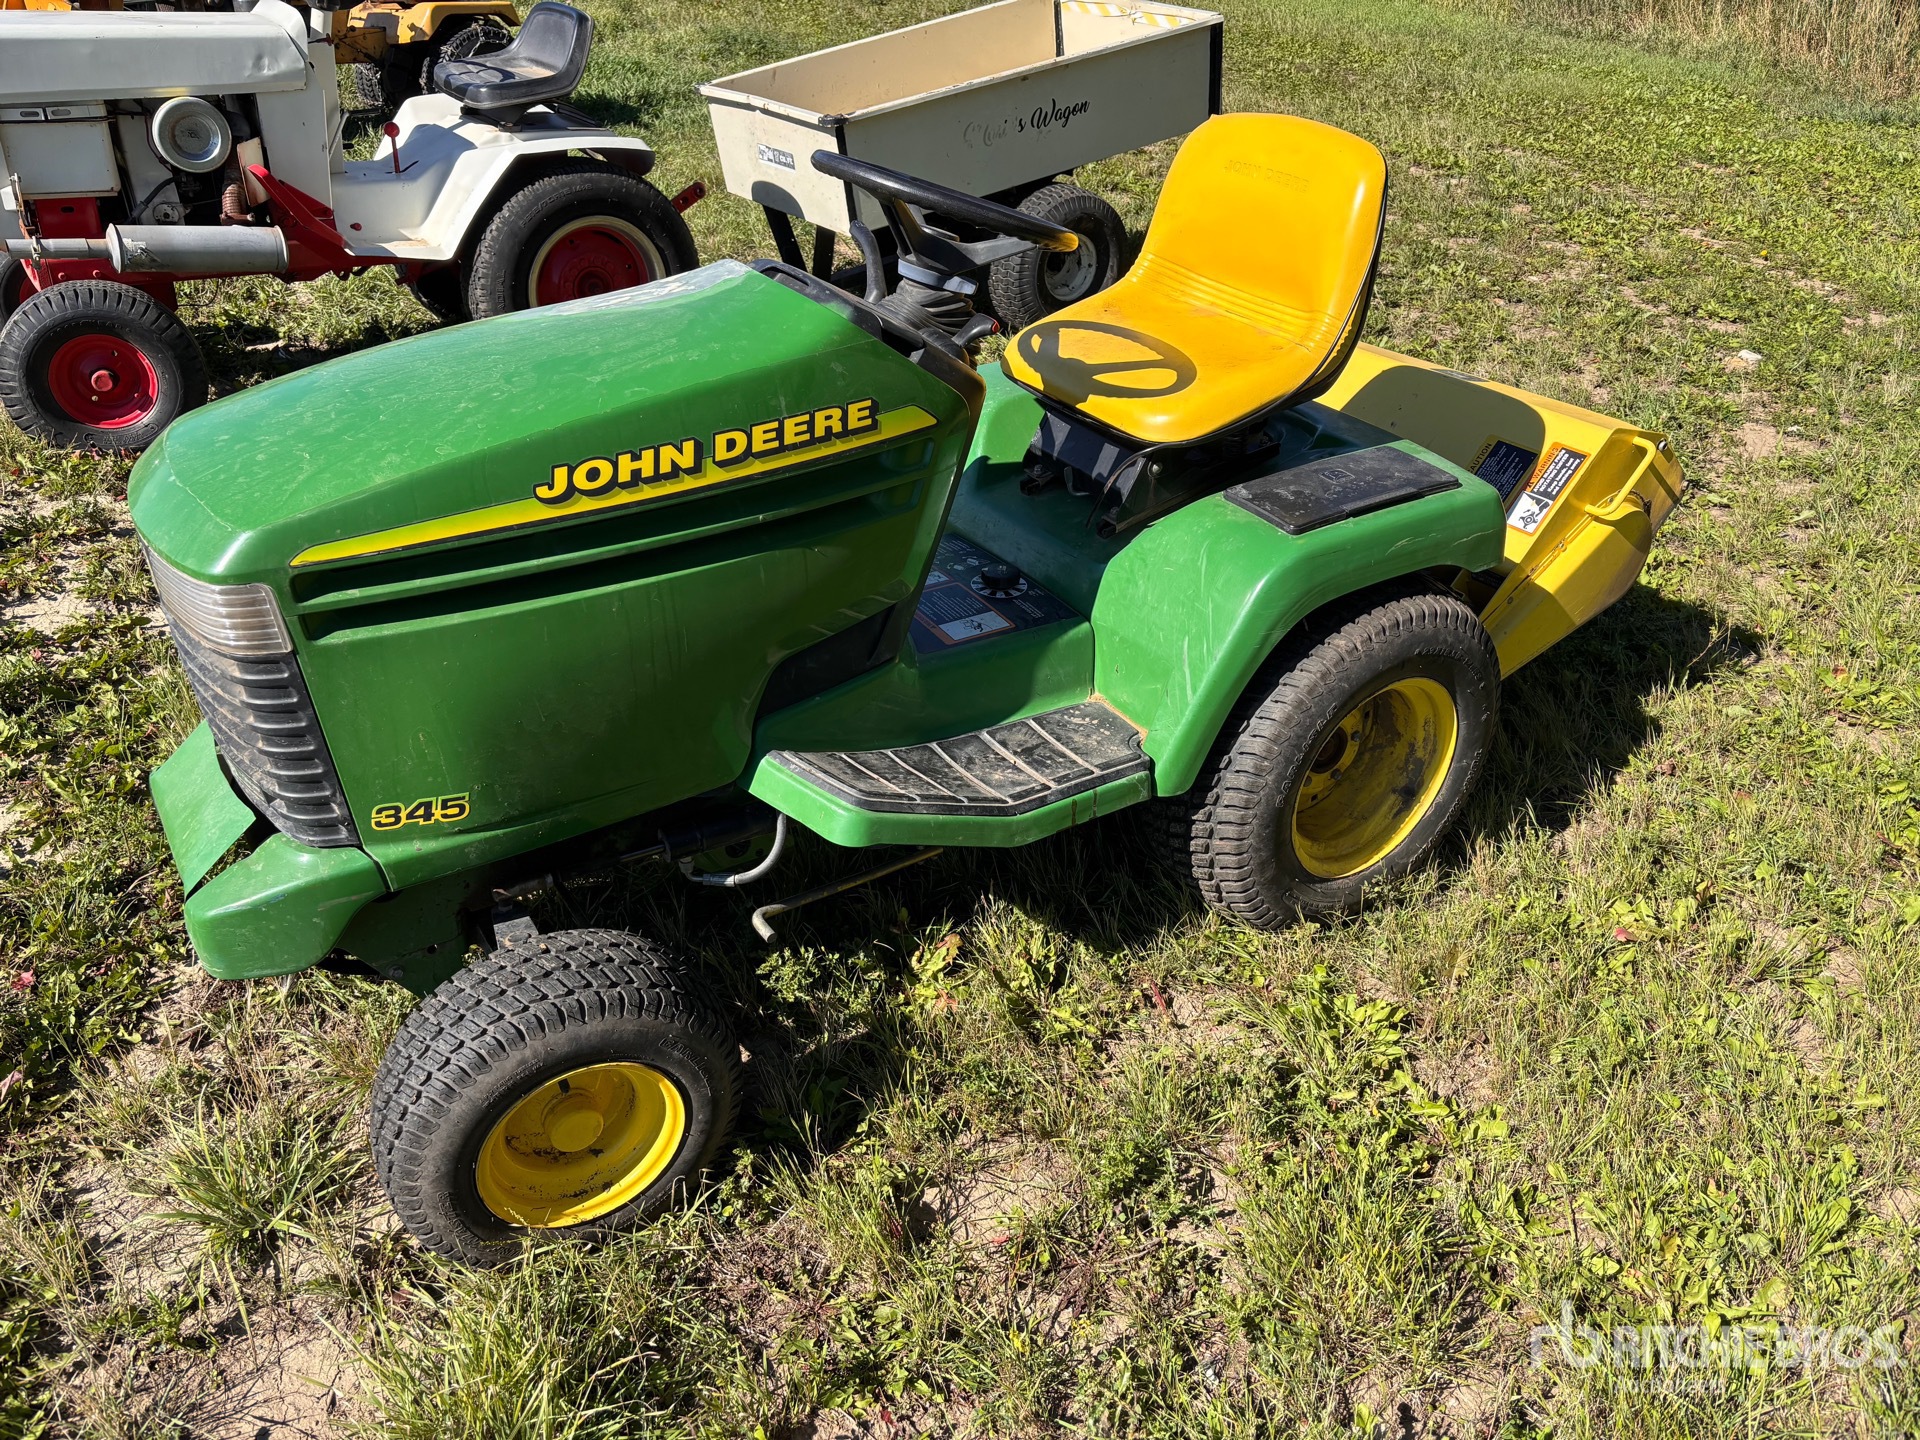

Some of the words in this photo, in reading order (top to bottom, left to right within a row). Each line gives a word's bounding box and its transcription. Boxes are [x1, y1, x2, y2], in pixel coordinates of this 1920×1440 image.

[1031, 97, 1090, 129] Wagon
[1224, 160, 1261, 179] JOHN
[1264, 167, 1310, 194] DEERE
[533, 437, 703, 505] JOHN
[712, 397, 881, 470] DEERE
[1533, 446, 1558, 479] WARNING
[371, 792, 470, 831] 345
